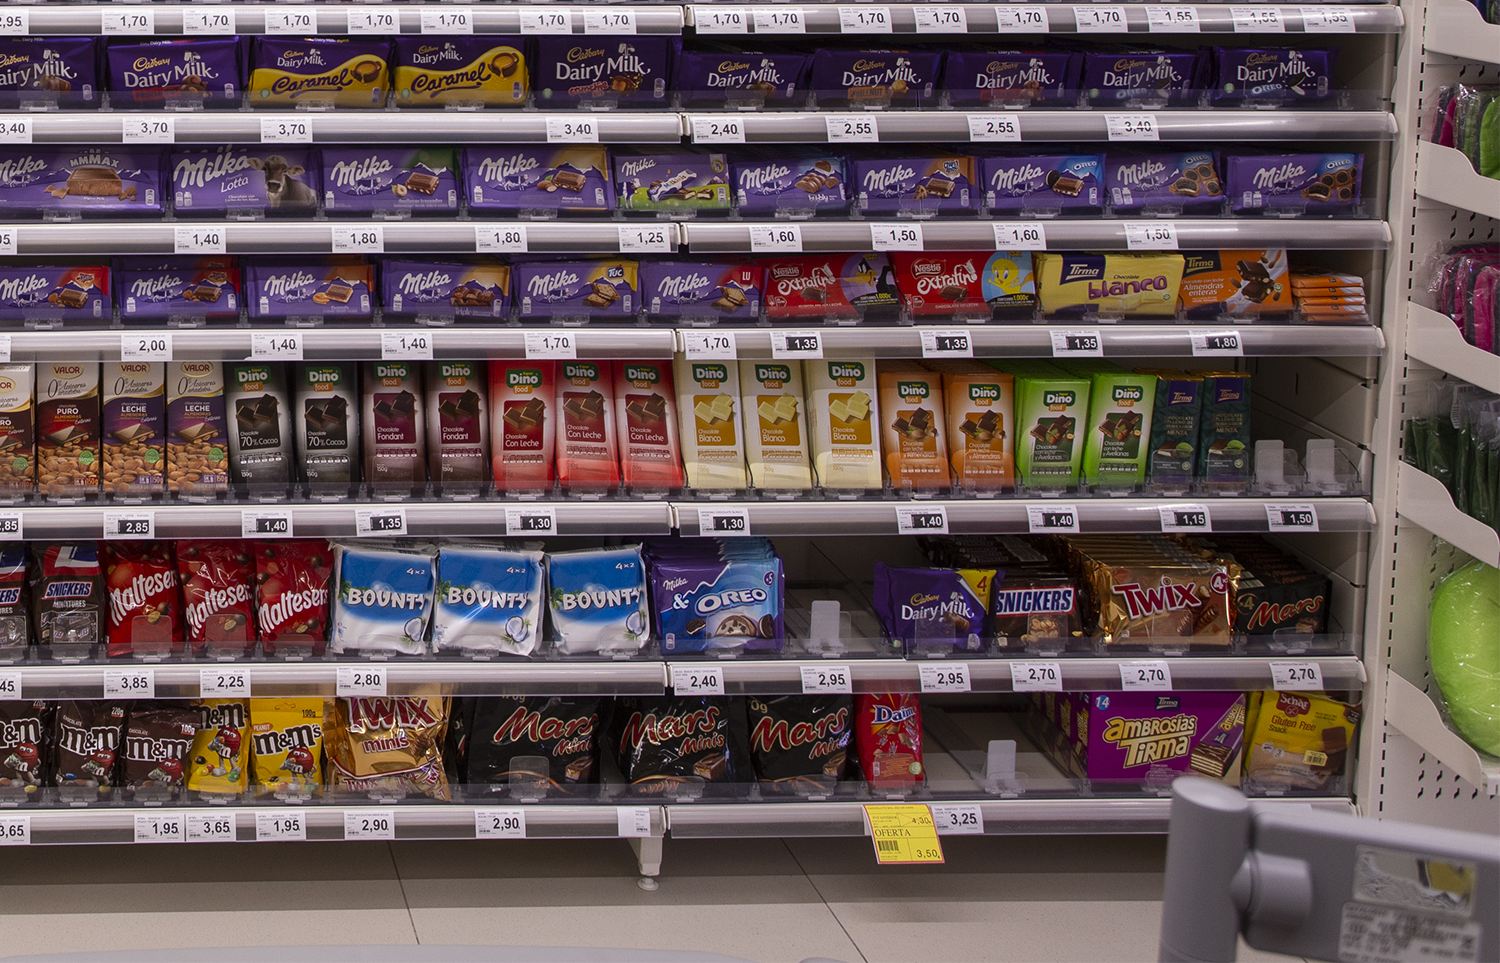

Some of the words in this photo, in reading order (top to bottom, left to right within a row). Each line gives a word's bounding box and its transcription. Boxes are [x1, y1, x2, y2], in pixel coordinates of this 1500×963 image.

[272, 70, 353, 97] Caramel
[330, 156, 393, 187] Milka
[220, 175, 248, 193] Lotta
[1069, 265, 1100, 281] Tirma
[1088, 275, 1168, 301] blanco
[238, 369, 268, 383] Dino
[510, 372, 539, 385] Dino
[831, 366, 861, 378] Dino
[121, 405, 147, 414] LECHE
[833, 432, 857, 441] Blanco
[348, 587, 427, 611] BOUNTY
[697, 589, 766, 614] OREO
[1248, 595, 1323, 630] Mars
[872, 705, 915, 725] Daim
[1271, 715, 1296, 728] Gluten
[363, 735, 410, 754] minis
[874, 828, 911, 837] OFERTA
